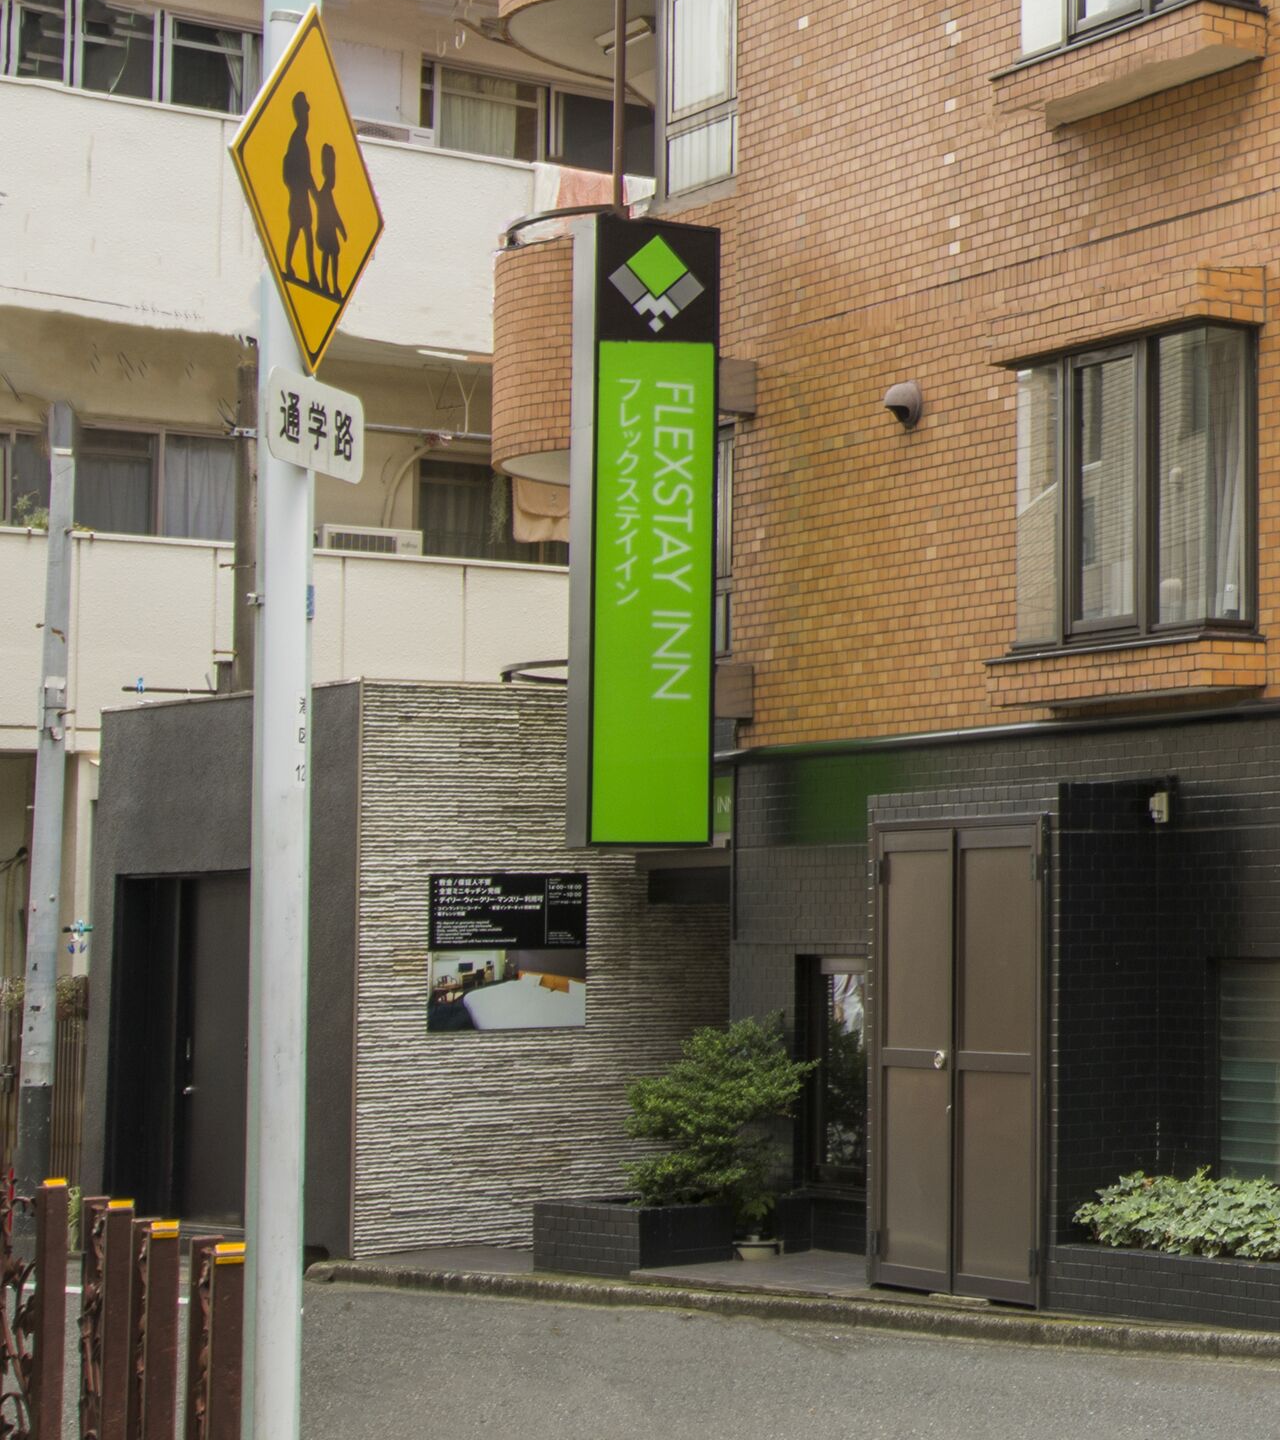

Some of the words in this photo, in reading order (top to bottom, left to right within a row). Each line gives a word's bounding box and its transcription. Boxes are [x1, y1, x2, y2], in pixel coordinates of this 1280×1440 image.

[279, 389, 354, 462] 通学路
[614, 377, 642, 606] フレックスステイイン
[652, 380, 694, 594] FLEXSTAY
[651, 610, 692, 700] INN
